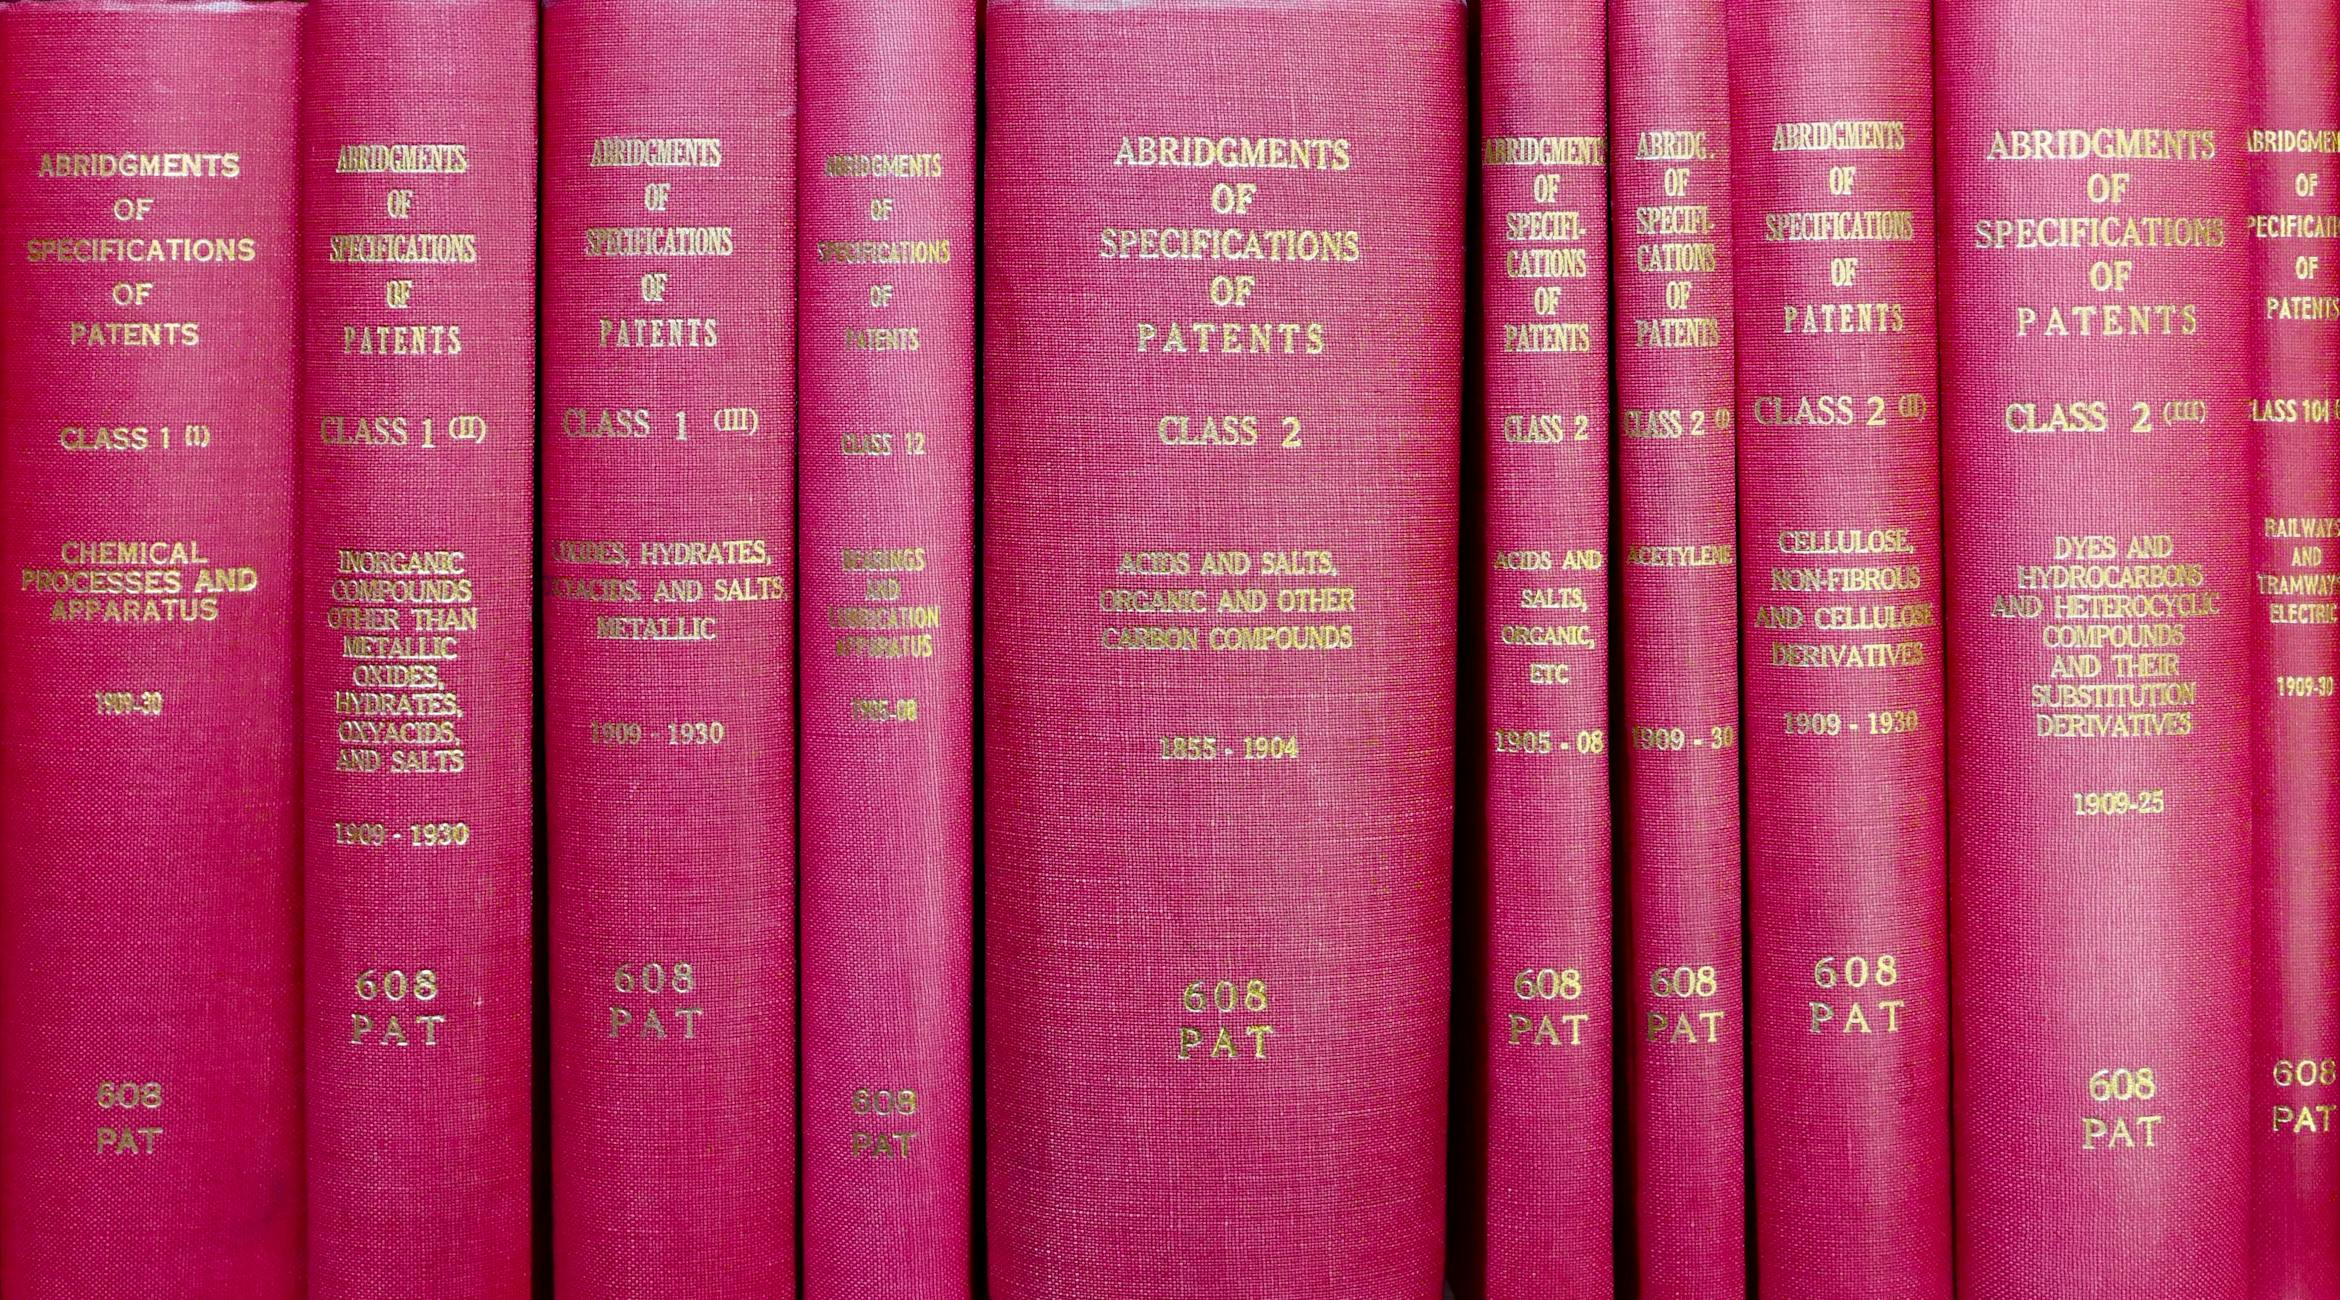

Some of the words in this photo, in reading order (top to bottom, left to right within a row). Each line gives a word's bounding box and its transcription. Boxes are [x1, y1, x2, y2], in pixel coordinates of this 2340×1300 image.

[1635, 131, 1715, 160] ABRIDG.
[1772, 121, 1905, 151] ABRIDGMENTS
[1987, 128, 2215, 160] ABRIDGMENTS
[39, 153, 240, 178] ABRIDGMENTS
[336, 145, 468, 174] ABRIDGMENTS
[590, 138, 722, 168] ABRIDGMENTS
[1113, 136, 1351, 171] ABRIDGMENTS
[1533, 173, 1561, 204] OF
[1664, 168, 1690, 197] OF
[1829, 166, 1856, 196] OF
[2086, 172, 2130, 203] OF
[2295, 172, 2318, 197] OF
[113, 198, 154, 221] OF
[387, 190, 413, 219] OF
[644, 184, 671, 212] OF
[870, 198, 894, 221] OF
[1211, 183, 1258, 215] OF
[1765, 212, 1913, 241] SPECIFICATIONS
[1976, 216, 2225, 249] SPECIFICATIONS
[26, 239, 256, 262] SPECIFICATIONS
[329, 234, 477, 263] SPECIFICATIONS
[584, 227, 734, 257] SPECIFICATIONS
[1100, 228, 1360, 262] SPECIFICATIONS
[1506, 249, 1587, 278] CATIONS
[1637, 243, 1716, 273] CATIONS
[1831, 257, 1858, 287] OF
[2295, 256, 2319, 280] OF
[640, 273, 669, 302] OF
[2089, 260, 2132, 292] OF
[112, 283, 154, 306] OF
[386, 281, 413, 309] OF
[869, 285, 893, 307] OF
[1209, 275, 1256, 308] OF
[1533, 286, 1561, 316] OF
[1665, 281, 1692, 311] OF
[1635, 318, 1720, 348] PATENTS
[1784, 305, 1904, 333] PATENTS
[2016, 305, 2197, 336] PATENTS
[71, 323, 199, 346] PATENTS
[344, 326, 462, 354] PATENTS
[599, 319, 718, 348] PATENTS
[845, 328, 920, 351] PATENTS
[1137, 322, 1324, 355] PATENTS
[1504, 323, 1590, 352] PATENTS
[562, 410, 651, 438] CLASS
[713, 408, 759, 436] (III)
[1754, 395, 1853, 426] CLASS
[1867, 396, 1886, 426] 2
[1898, 393, 1927, 421] (II)
[2005, 402, 2108, 433] CLASS
[2131, 402, 2152, 433] 2
[2163, 401, 2206, 427] (III)
[2302, 399, 2329, 424] 104
[60, 427, 149, 450] CLASS
[185, 426, 211, 448] (I)
[320, 417, 408, 445] CLASS
[449, 415, 486, 444] (II)
[1158, 415, 1259, 447] CLASS
[1281, 416, 1302, 448] 2
[1503, 415, 1563, 443] CLASS
[1574, 415, 1589, 441] 2
[1623, 410, 1682, 439] CLASS
[1690, 410, 1705, 437] 2
[841, 433, 892, 456] CLASS
[905, 431, 927, 456] 12
[61, 541, 208, 565] CHEMICAL
[640, 540, 772, 566] HYDRATES,
[1778, 529, 1914, 554] CELLULOSE,
[2054, 535, 2116, 560] DYES
[2126, 535, 2173, 559] AND
[338, 550, 464, 575] INORGANIC
[1119, 551, 1190, 575] ACIDS
[1199, 551, 1251, 576] AND
[1260, 551, 1338, 577] SALTS,
[1494, 550, 1552, 571] ACIDS
[1562, 550, 1602, 571] AND
[2291, 546, 2323, 567] AND
[21, 568, 181, 594] PROCESSES
[194, 567, 258, 593] AND
[654, 580, 704, 603] AND
[714, 576, 788, 602] SALTS,
[865, 578, 900, 601] AND
[1771, 566, 1921, 592] NON-FIBROUS
[2017, 564, 2204, 590] HYDROCARBONS
[331, 580, 472, 603] COMPOUNDS
[1100, 589, 1207, 613] ORGANIC
[1217, 588, 1268, 613] AND
[1276, 587, 1355, 613] OTHER
[1520, 588, 1589, 612] SALTS,
[1991, 595, 2044, 619] AND
[2054, 592, 2220, 619] HETEROCYCLIC
[51, 599, 218, 623] APPARATUS
[327, 608, 399, 631] OTHER
[411, 607, 477, 631] THAN
[1754, 606, 1804, 629] AND
[1814, 603, 1934, 629] CELLULOSE
[2269, 603, 2338, 624] ELECTRIC
[596, 617, 716, 641] METALLIC
[1102, 627, 1199, 651] CARBON
[1208, 625, 1354, 650] COMPOUNDS
[1501, 626, 1596, 650] ORGANIC,
[2042, 624, 2185, 649] COMPOUNDS
[343, 637, 458, 660] METALLIC
[1772, 641, 1924, 668] DERIVATIVES
[352, 665, 446, 690] OXIDES,
[1529, 664, 1569, 685] ETC
[2050, 654, 2101, 679] AND
[2111, 653, 2180, 677] THEIR
[2031, 682, 2197, 709] SUBSTITUTION
[2276, 676, 2334, 697] 1909-30
[335, 692, 463, 718] HYDRATES,
[338, 721, 461, 746] OXYACIDS,
[591, 722, 641, 745] 1909
[668, 722, 725, 745] 1930
[1783, 711, 1841, 735] 1909
[1867, 711, 1918, 735] 1930
[2036, 711, 2192, 738] DERIVATIVES
[1160, 736, 1217, 760] 1855
[1242, 735, 1300, 760] 1904
[1494, 730, 1552, 754] 1905
[1576, 730, 1605, 754] 08
[1632, 726, 1685, 751] 1909
[1711, 726, 1733, 750] 30
[336, 750, 381, 773] AND
[390, 750, 464, 773] SALTS
[2073, 790, 2165, 816] 1909-25
[334, 822, 385, 845] 1909
[410, 822, 469, 847] 1930
[613, 962, 696, 995] 608
[1514, 967, 1583, 1000] 608
[1651, 966, 1716, 998] 608
[1814, 954, 1897, 988] 608
[355, 970, 439, 1002] 608
[1183, 980, 1268, 1013] 608
[350, 1013, 446, 1047] PAT
[608, 1007, 705, 1040] PAT
[1508, 1013, 1589, 1046] PAT
[1646, 1011, 1725, 1044] PAT
[1809, 999, 1904, 1034] PAT
[1177, 1026, 1275, 1060] PAT
[2088, 1068, 2157, 1102] 608
[2273, 1060, 2337, 1087] 608
[97, 1082, 164, 1111] 608
[851, 1088, 917, 1117] 608
[2082, 1115, 2162, 1150] PAT
[2272, 1105, 2338, 1134] PAT
[96, 1127, 164, 1156] PAT
[851, 1132, 917, 1159] PAT
